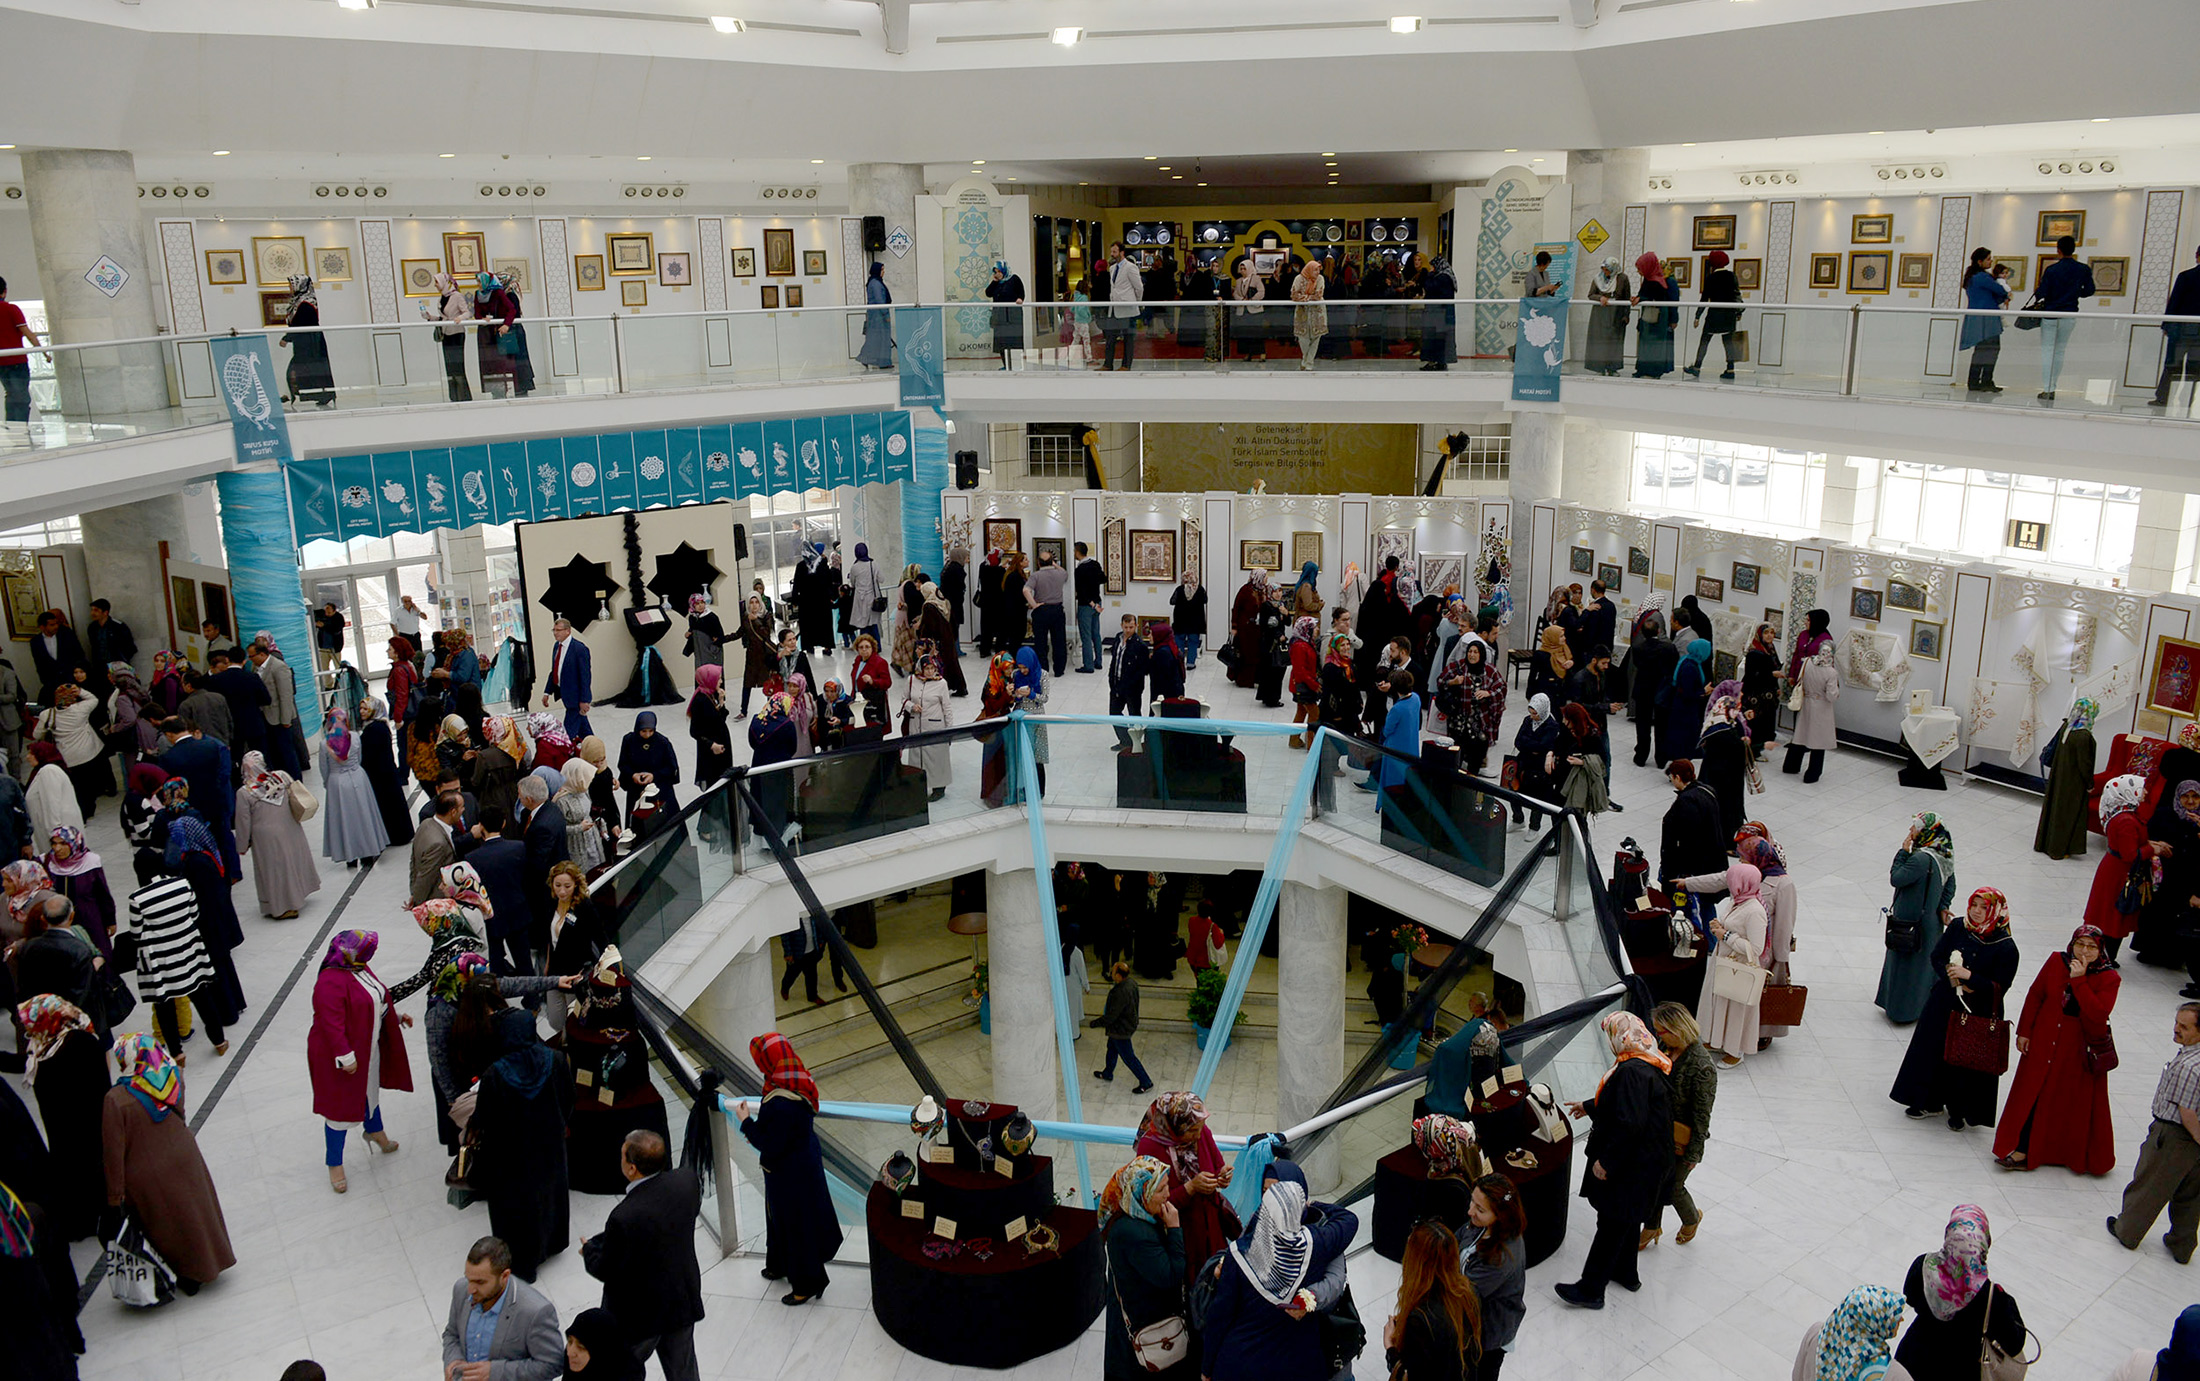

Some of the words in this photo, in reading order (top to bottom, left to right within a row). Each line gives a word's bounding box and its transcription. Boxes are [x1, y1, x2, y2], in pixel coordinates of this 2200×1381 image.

[1256, 426, 1303, 434] Geleneksel
[1274, 437, 1322, 445] Dokunuşlar
[1232, 448, 1252, 456] Türk
[1280, 448, 1326, 456] Sembolleri
[1234, 459, 1262, 469] Sergisi
[1277, 459, 1296, 469] Bilgi
[2020, 523, 2039, 542] H
